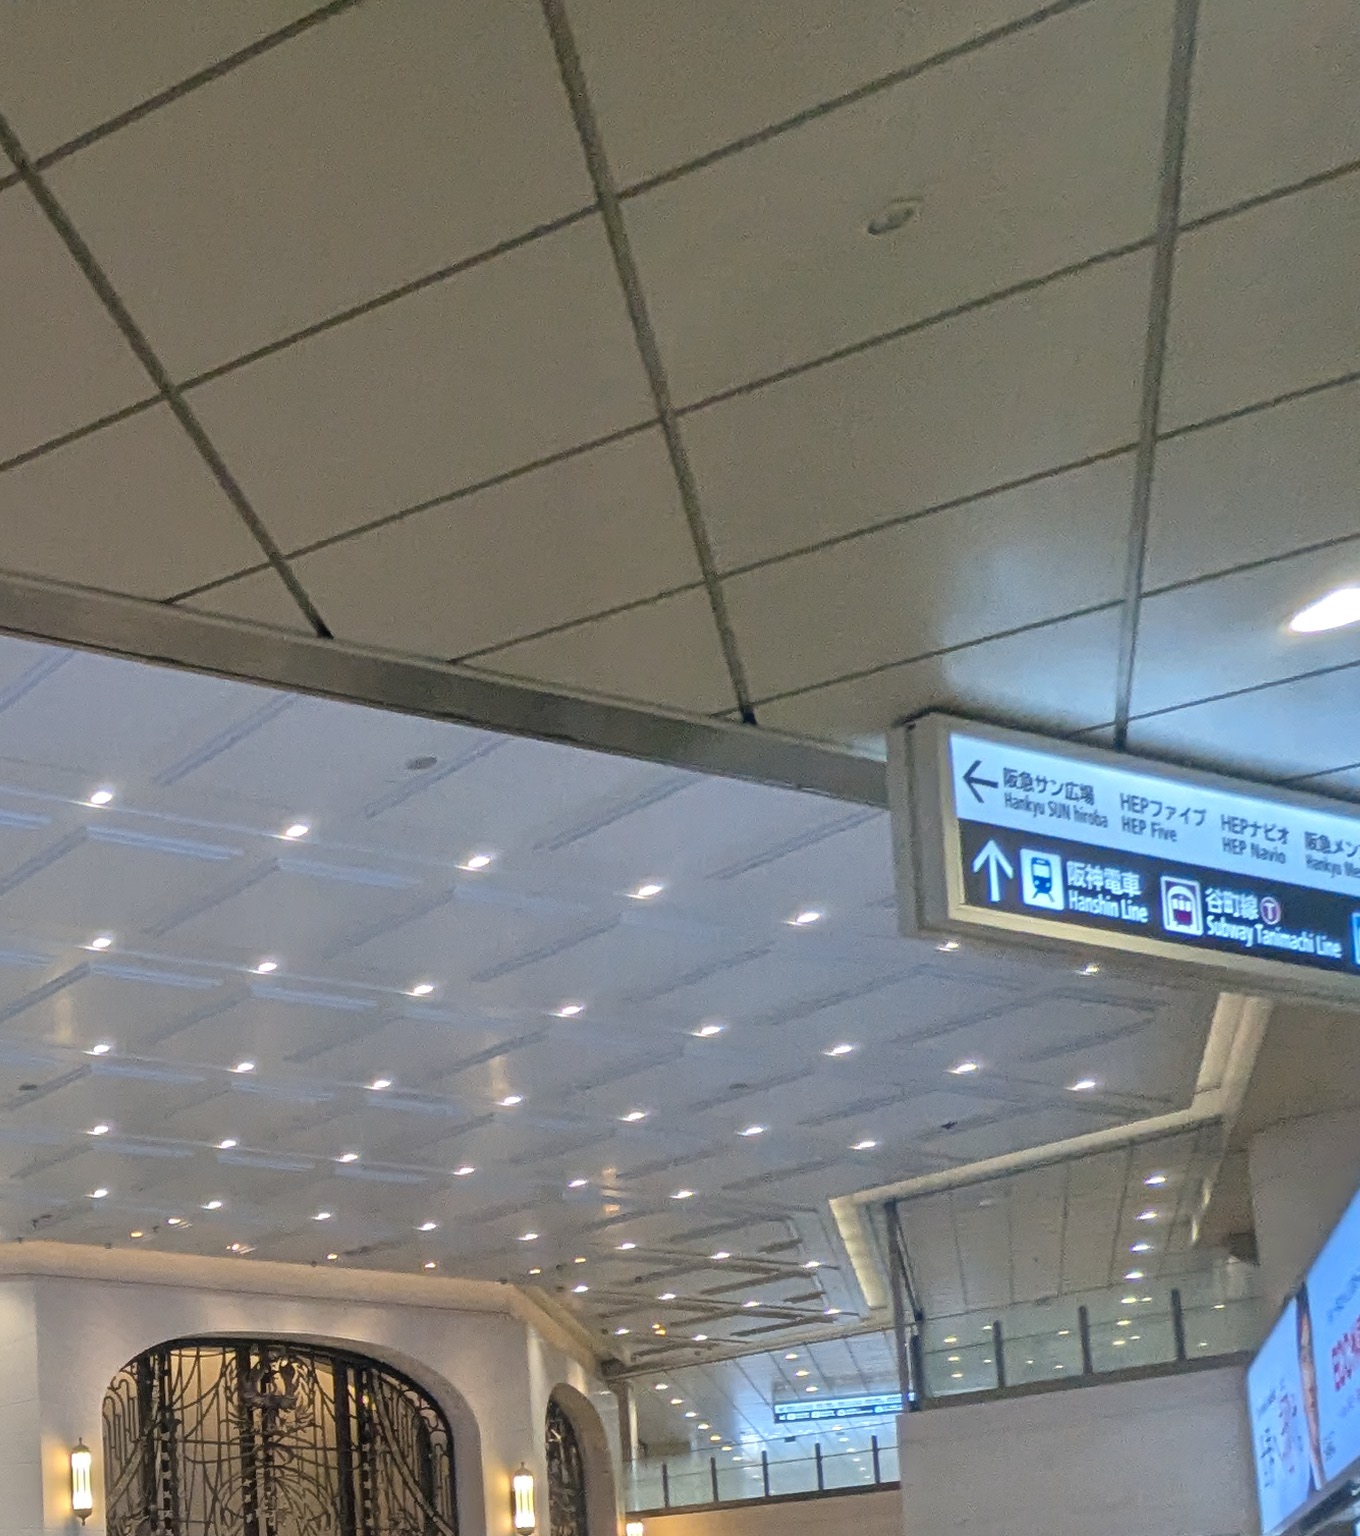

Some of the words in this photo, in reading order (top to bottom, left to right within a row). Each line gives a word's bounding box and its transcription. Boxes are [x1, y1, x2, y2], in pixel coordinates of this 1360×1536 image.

[1003, 767, 1095, 806] 阪急サン広場
[1119, 792, 1207, 826] HEPファイブ
[1304, 831, 1360, 857] 阪急メン
[1004, 792, 1046, 818] Hankyu
[1048, 801, 1071, 821] SUN
[1073, 804, 1108, 828] hiroba
[1121, 815, 1147, 836] HEP
[1151, 821, 1178, 842] Five
[1222, 836, 1247, 855] HEP
[1250, 842, 1286, 864] Navio
[1066, 860, 1142, 897] 阪神電車
[1068, 889, 1119, 918] Hanshin
[1122, 899, 1148, 923] Line
[1205, 887, 1259, 920] 谷町線
[1206, 915, 1254, 947] Subway
[1255, 924, 1315, 954] Tanimachi
[1316, 935, 1342, 958] Line
